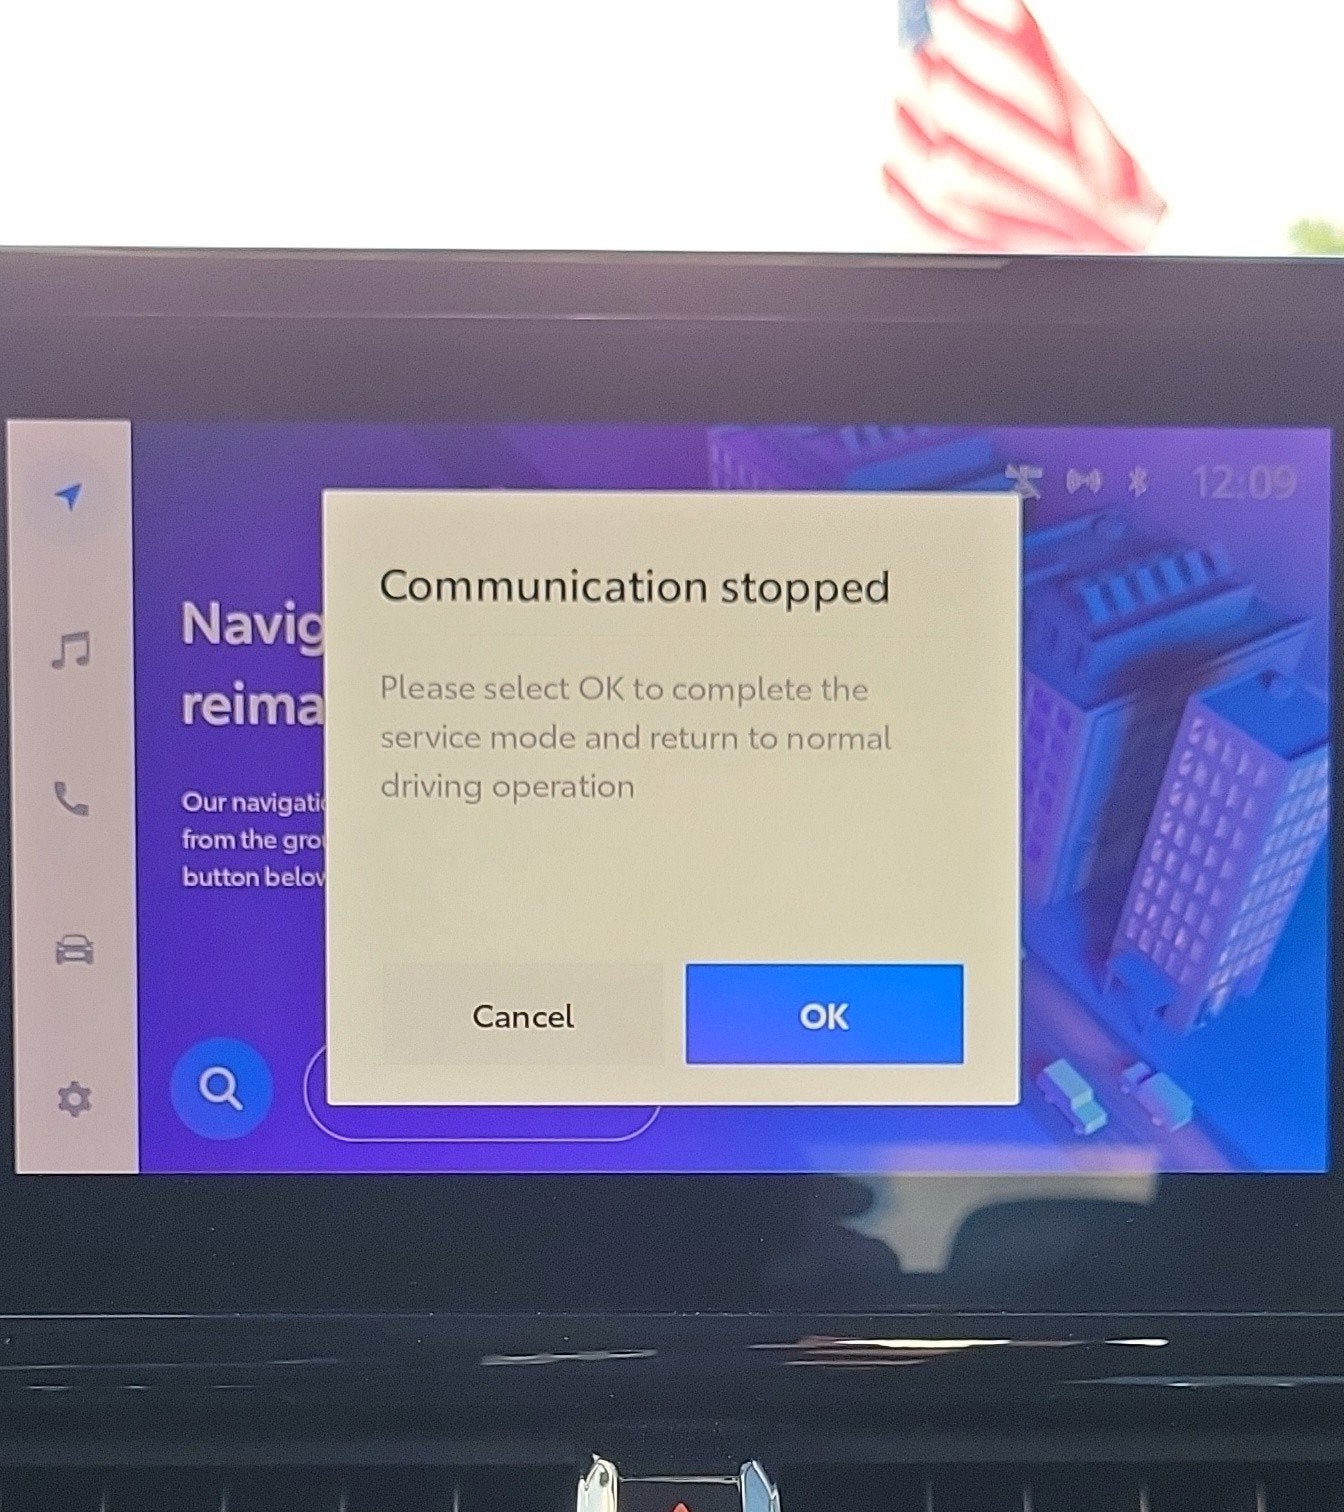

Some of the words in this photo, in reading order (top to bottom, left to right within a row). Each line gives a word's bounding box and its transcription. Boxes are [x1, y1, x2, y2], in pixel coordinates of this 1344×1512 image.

[1194, 464, 1298, 499] 12:09
[379, 568, 708, 604] Communication
[721, 570, 891, 613] stopped
[380, 674, 476, 701] Please
[483, 674, 570, 701] select
[579, 675, 625, 702] OK
[633, 677, 664, 702] to
[672, 675, 813, 708] complete
[821, 676, 870, 703] the
[380, 724, 482, 750] service
[490, 724, 576, 751] mode
[585, 724, 641, 751] and
[649, 727, 739, 751] return
[747, 727, 779, 752] to
[786, 724, 893, 752] normal
[182, 791, 228, 814] Our
[380, 772, 482, 805] driving
[491, 772, 635, 806] operation
[181, 828, 235, 851] from
[239, 828, 278, 851] the
[182, 865, 260, 888] button
[472, 1003, 575, 1031] Cancel
[799, 1003, 850, 1031] OK
